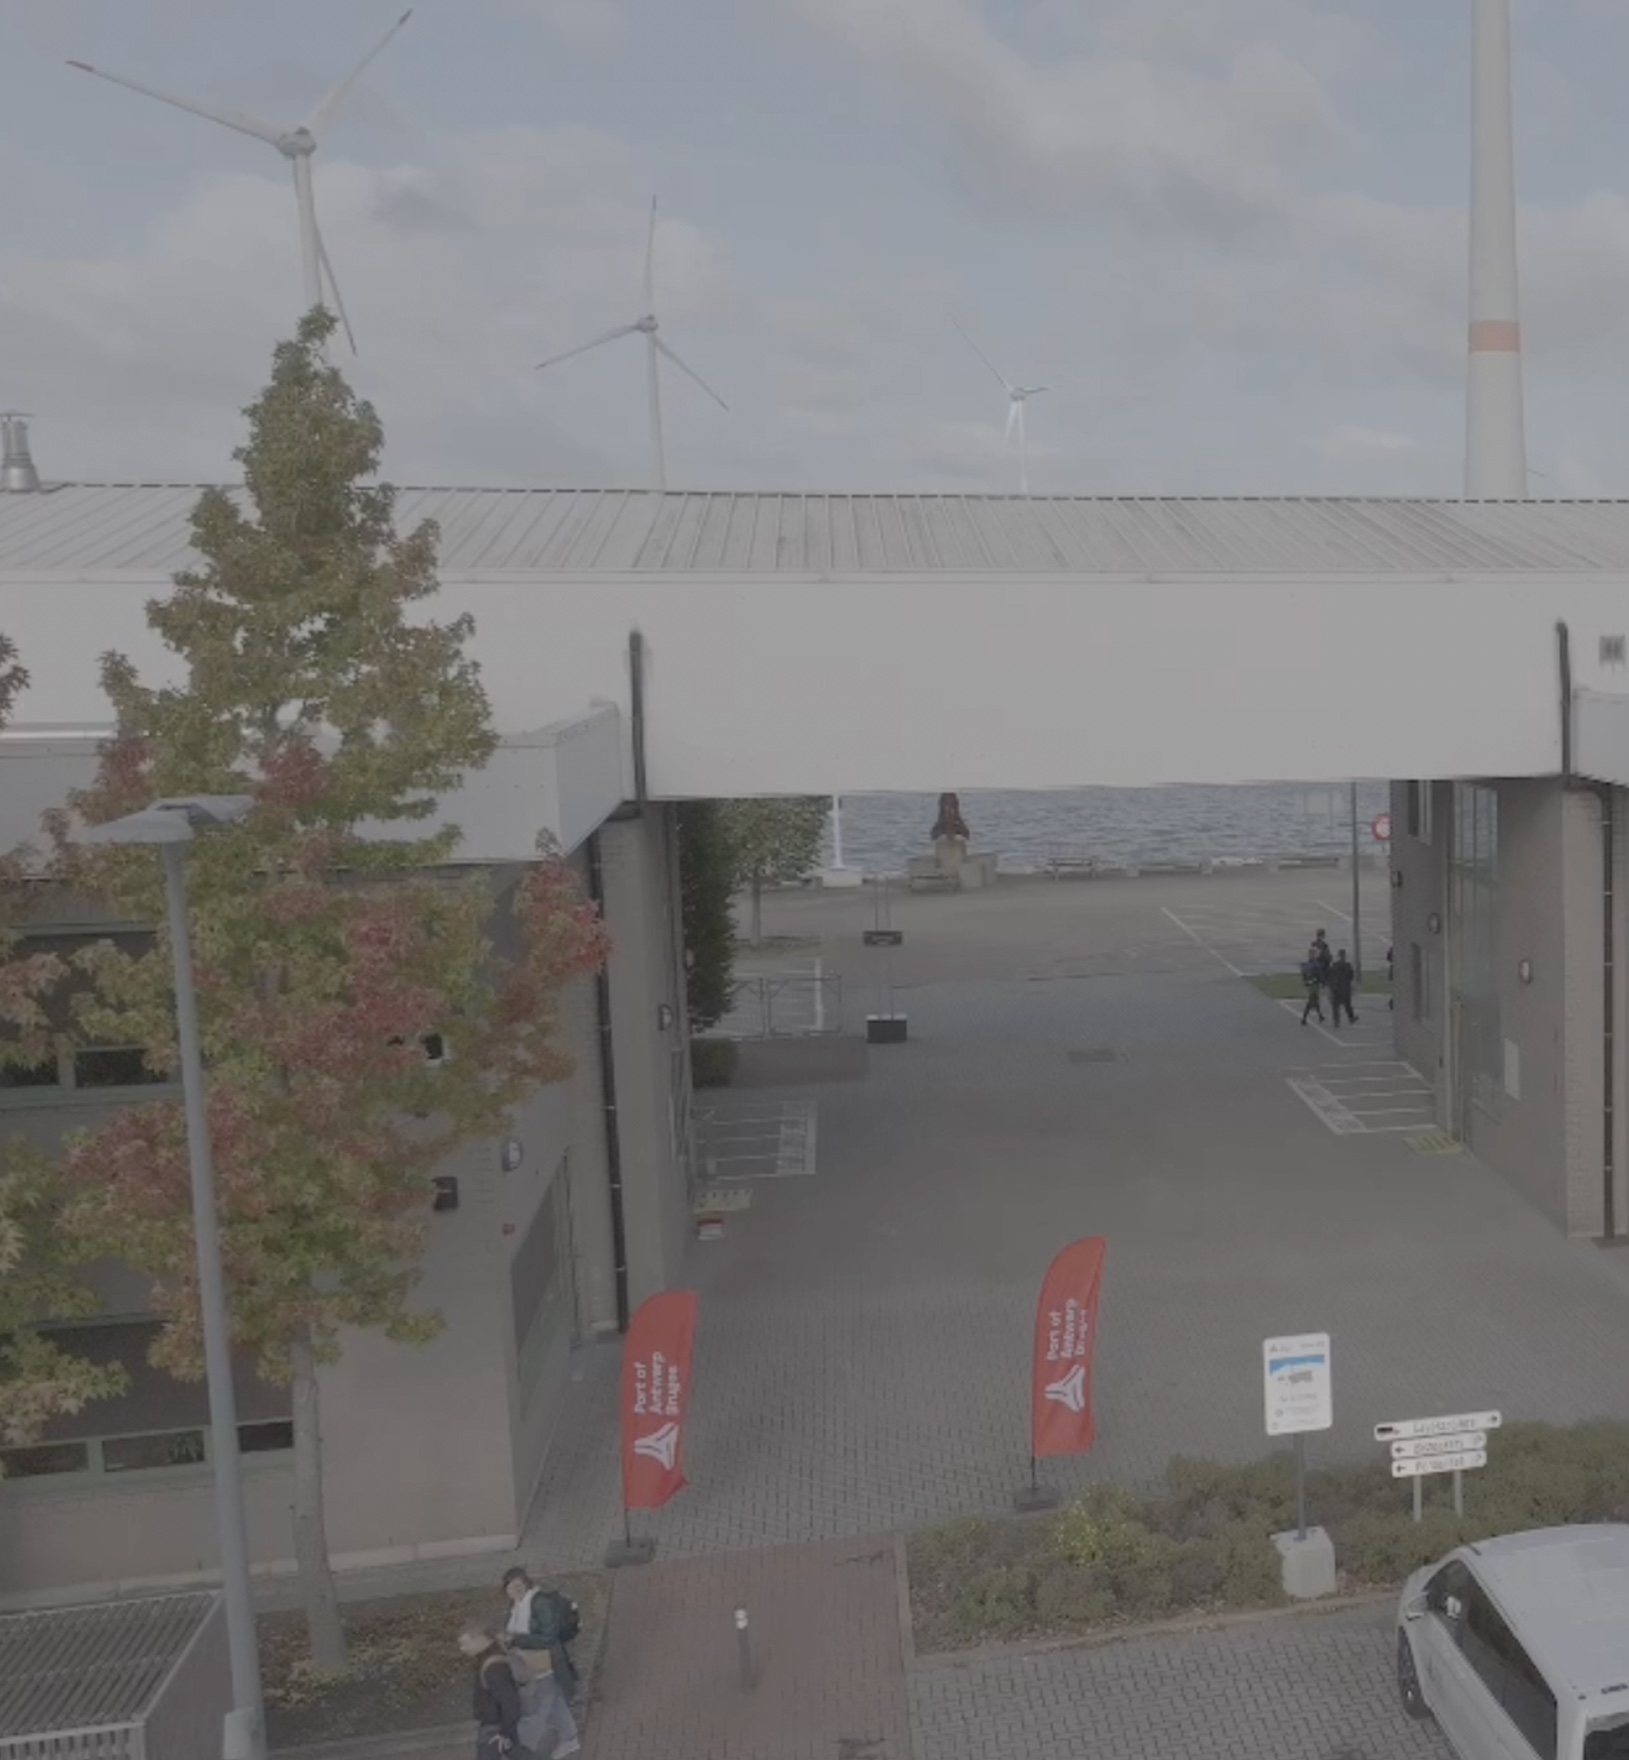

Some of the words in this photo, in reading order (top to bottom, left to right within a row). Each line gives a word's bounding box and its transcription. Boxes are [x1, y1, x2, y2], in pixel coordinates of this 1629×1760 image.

[633, 1361, 646, 1379] of
[648, 1351, 667, 1415] Antwerp
[666, 1365, 681, 1416] Bruges
[634, 1382, 647, 1414] Port
